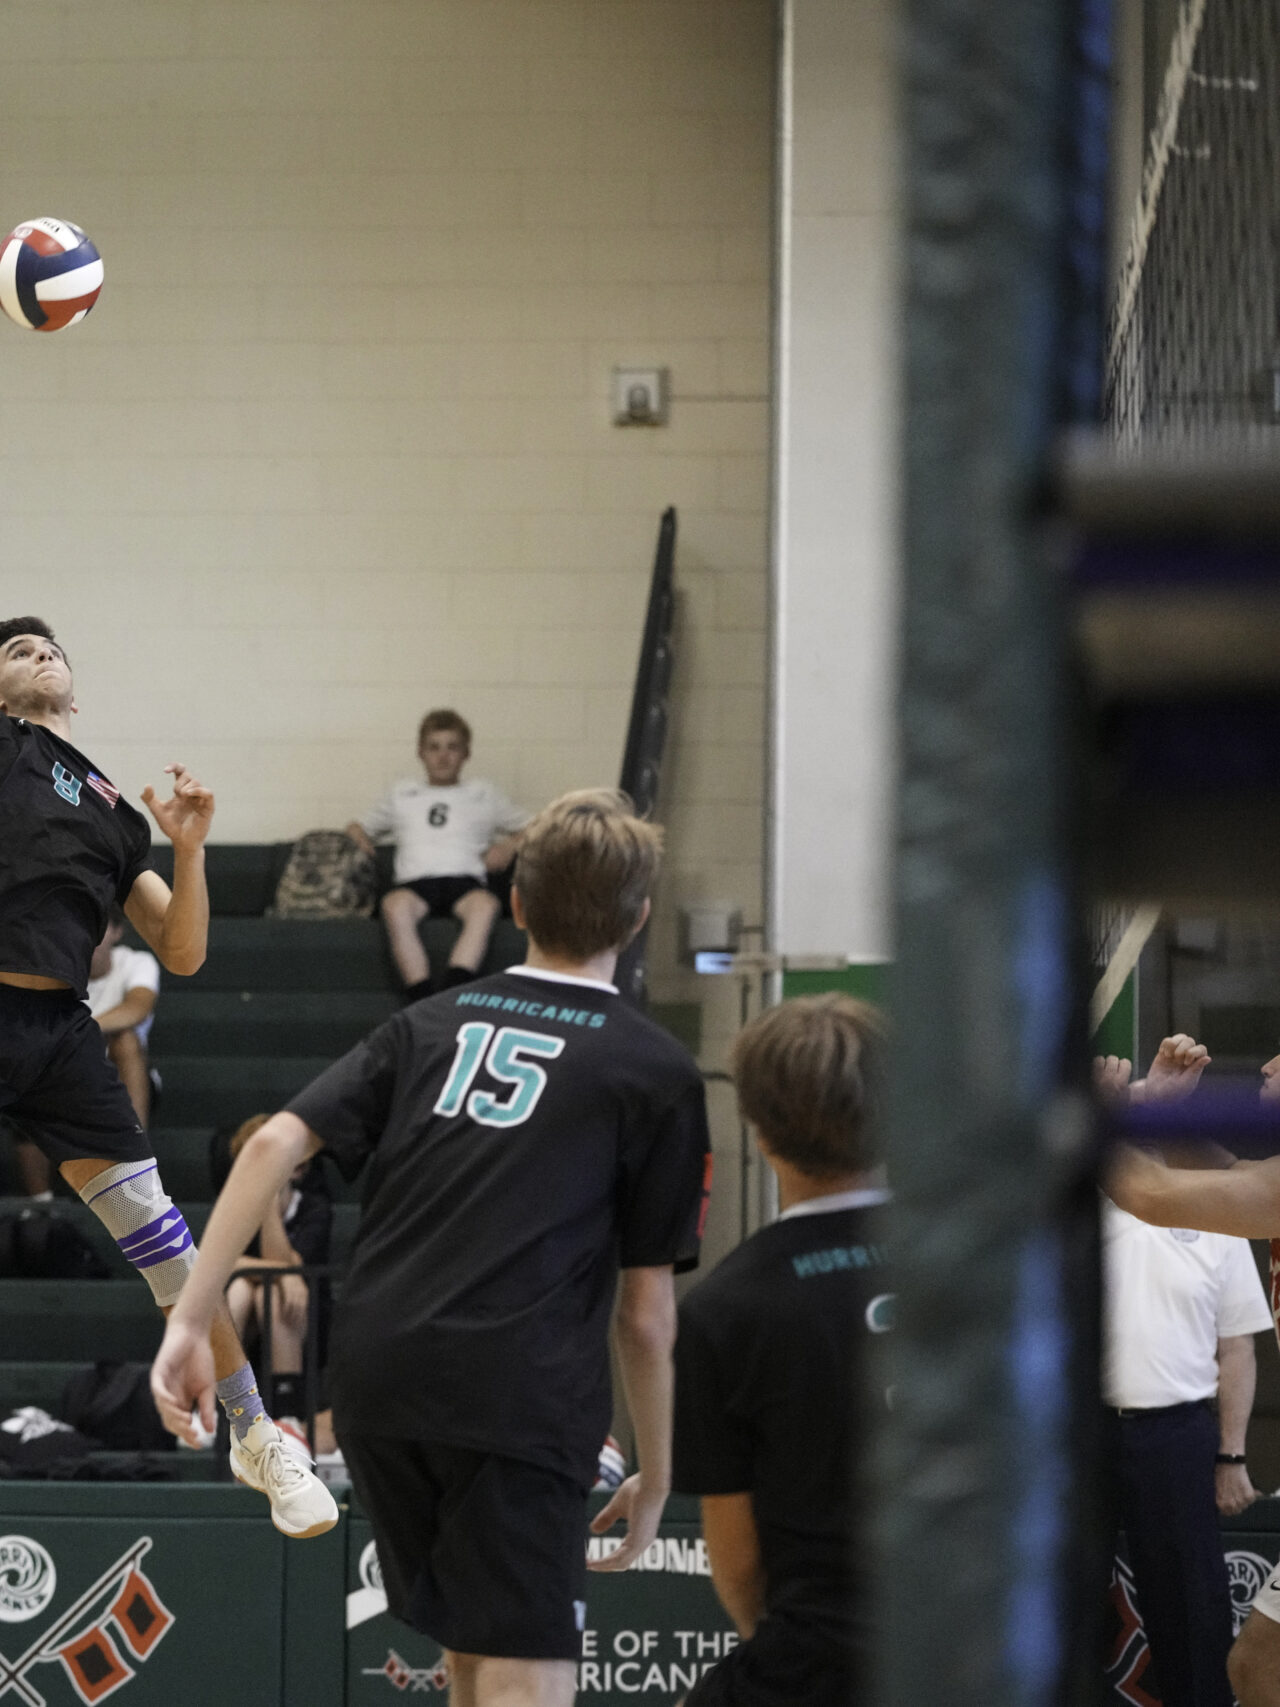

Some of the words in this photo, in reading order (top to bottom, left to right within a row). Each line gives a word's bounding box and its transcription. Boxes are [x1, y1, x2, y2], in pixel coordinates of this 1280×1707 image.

[427, 801, 451, 828] 6
[455, 992, 607, 1029] HURRICANES
[433, 1021, 566, 1128] 15
[613, 1630, 659, 1658] OF
